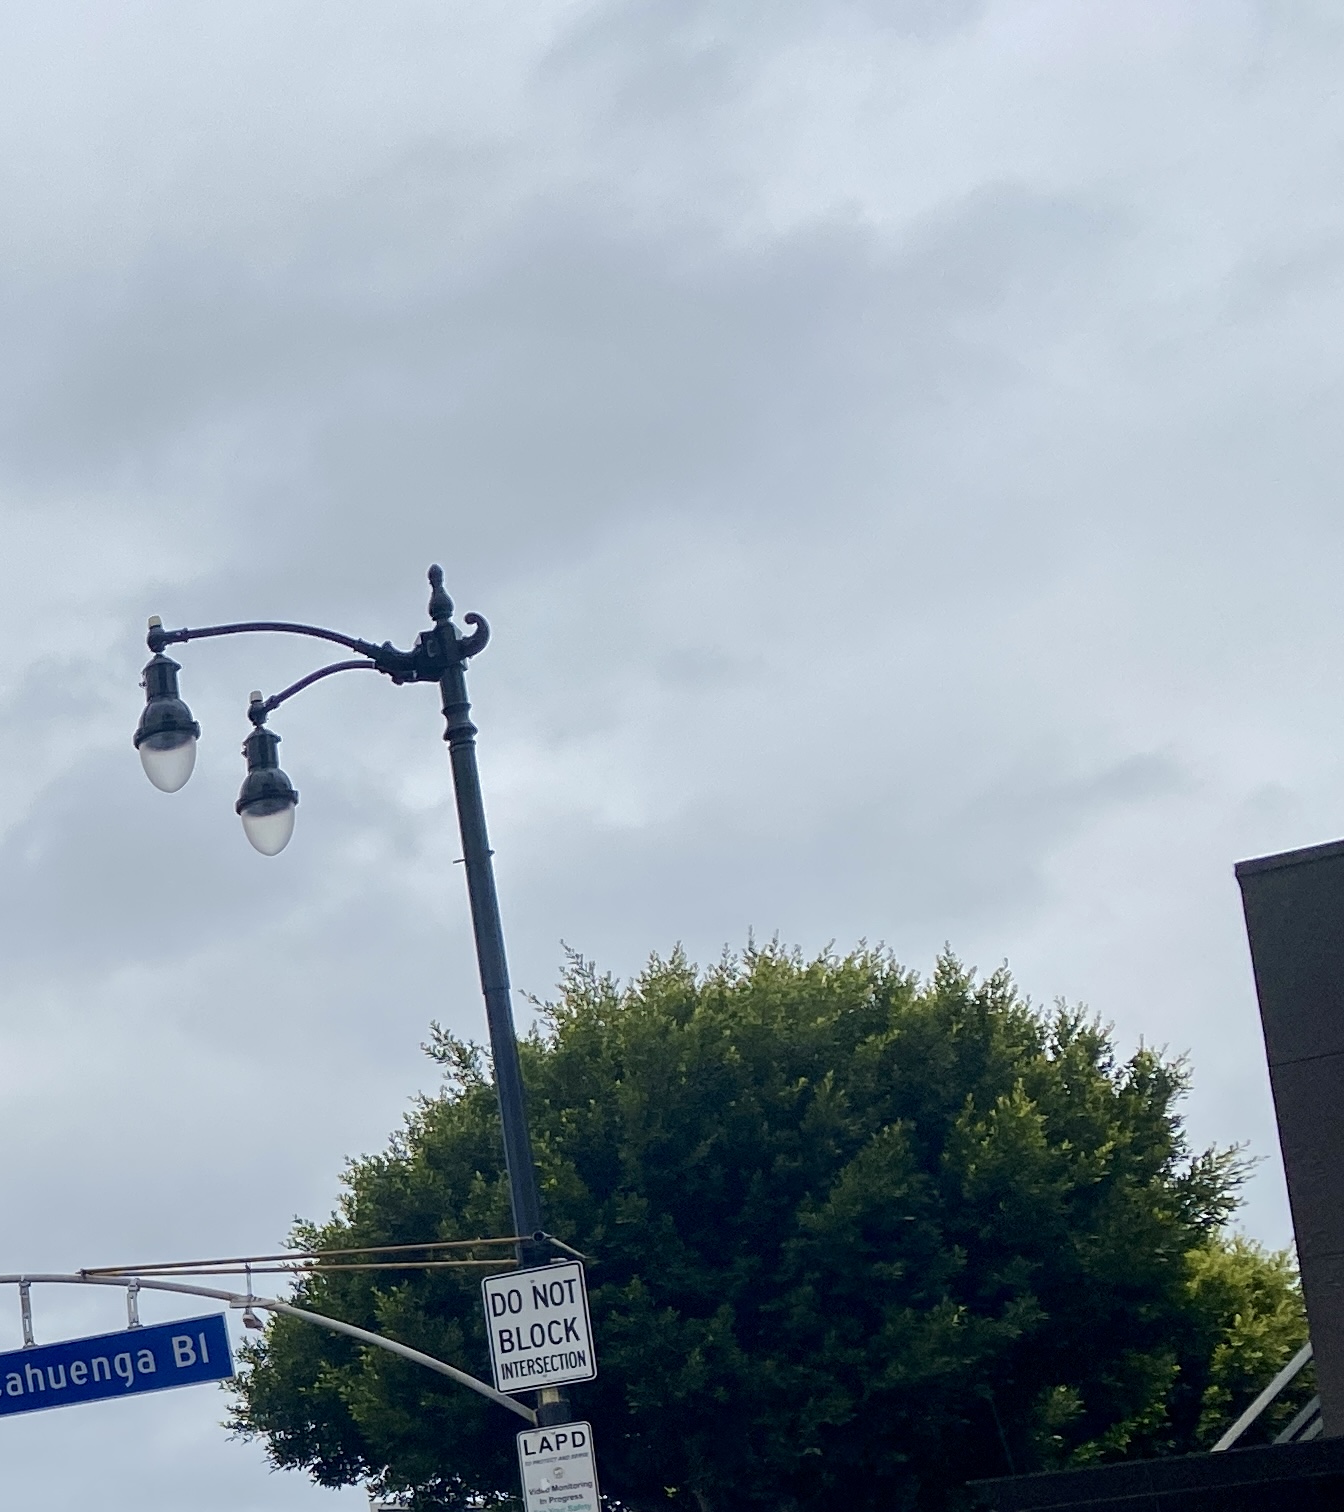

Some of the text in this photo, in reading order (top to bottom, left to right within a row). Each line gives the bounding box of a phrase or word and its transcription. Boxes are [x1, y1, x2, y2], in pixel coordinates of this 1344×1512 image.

[491, 1279, 577, 1318] DO NOT
[171, 1332, 210, 1368] Bl
[498, 1317, 580, 1354] BLOCK
[501, 1350, 587, 1381] INTERSECTION
[523, 1431, 586, 1456] LAPD
[549, 1494, 584, 1504] Progress
